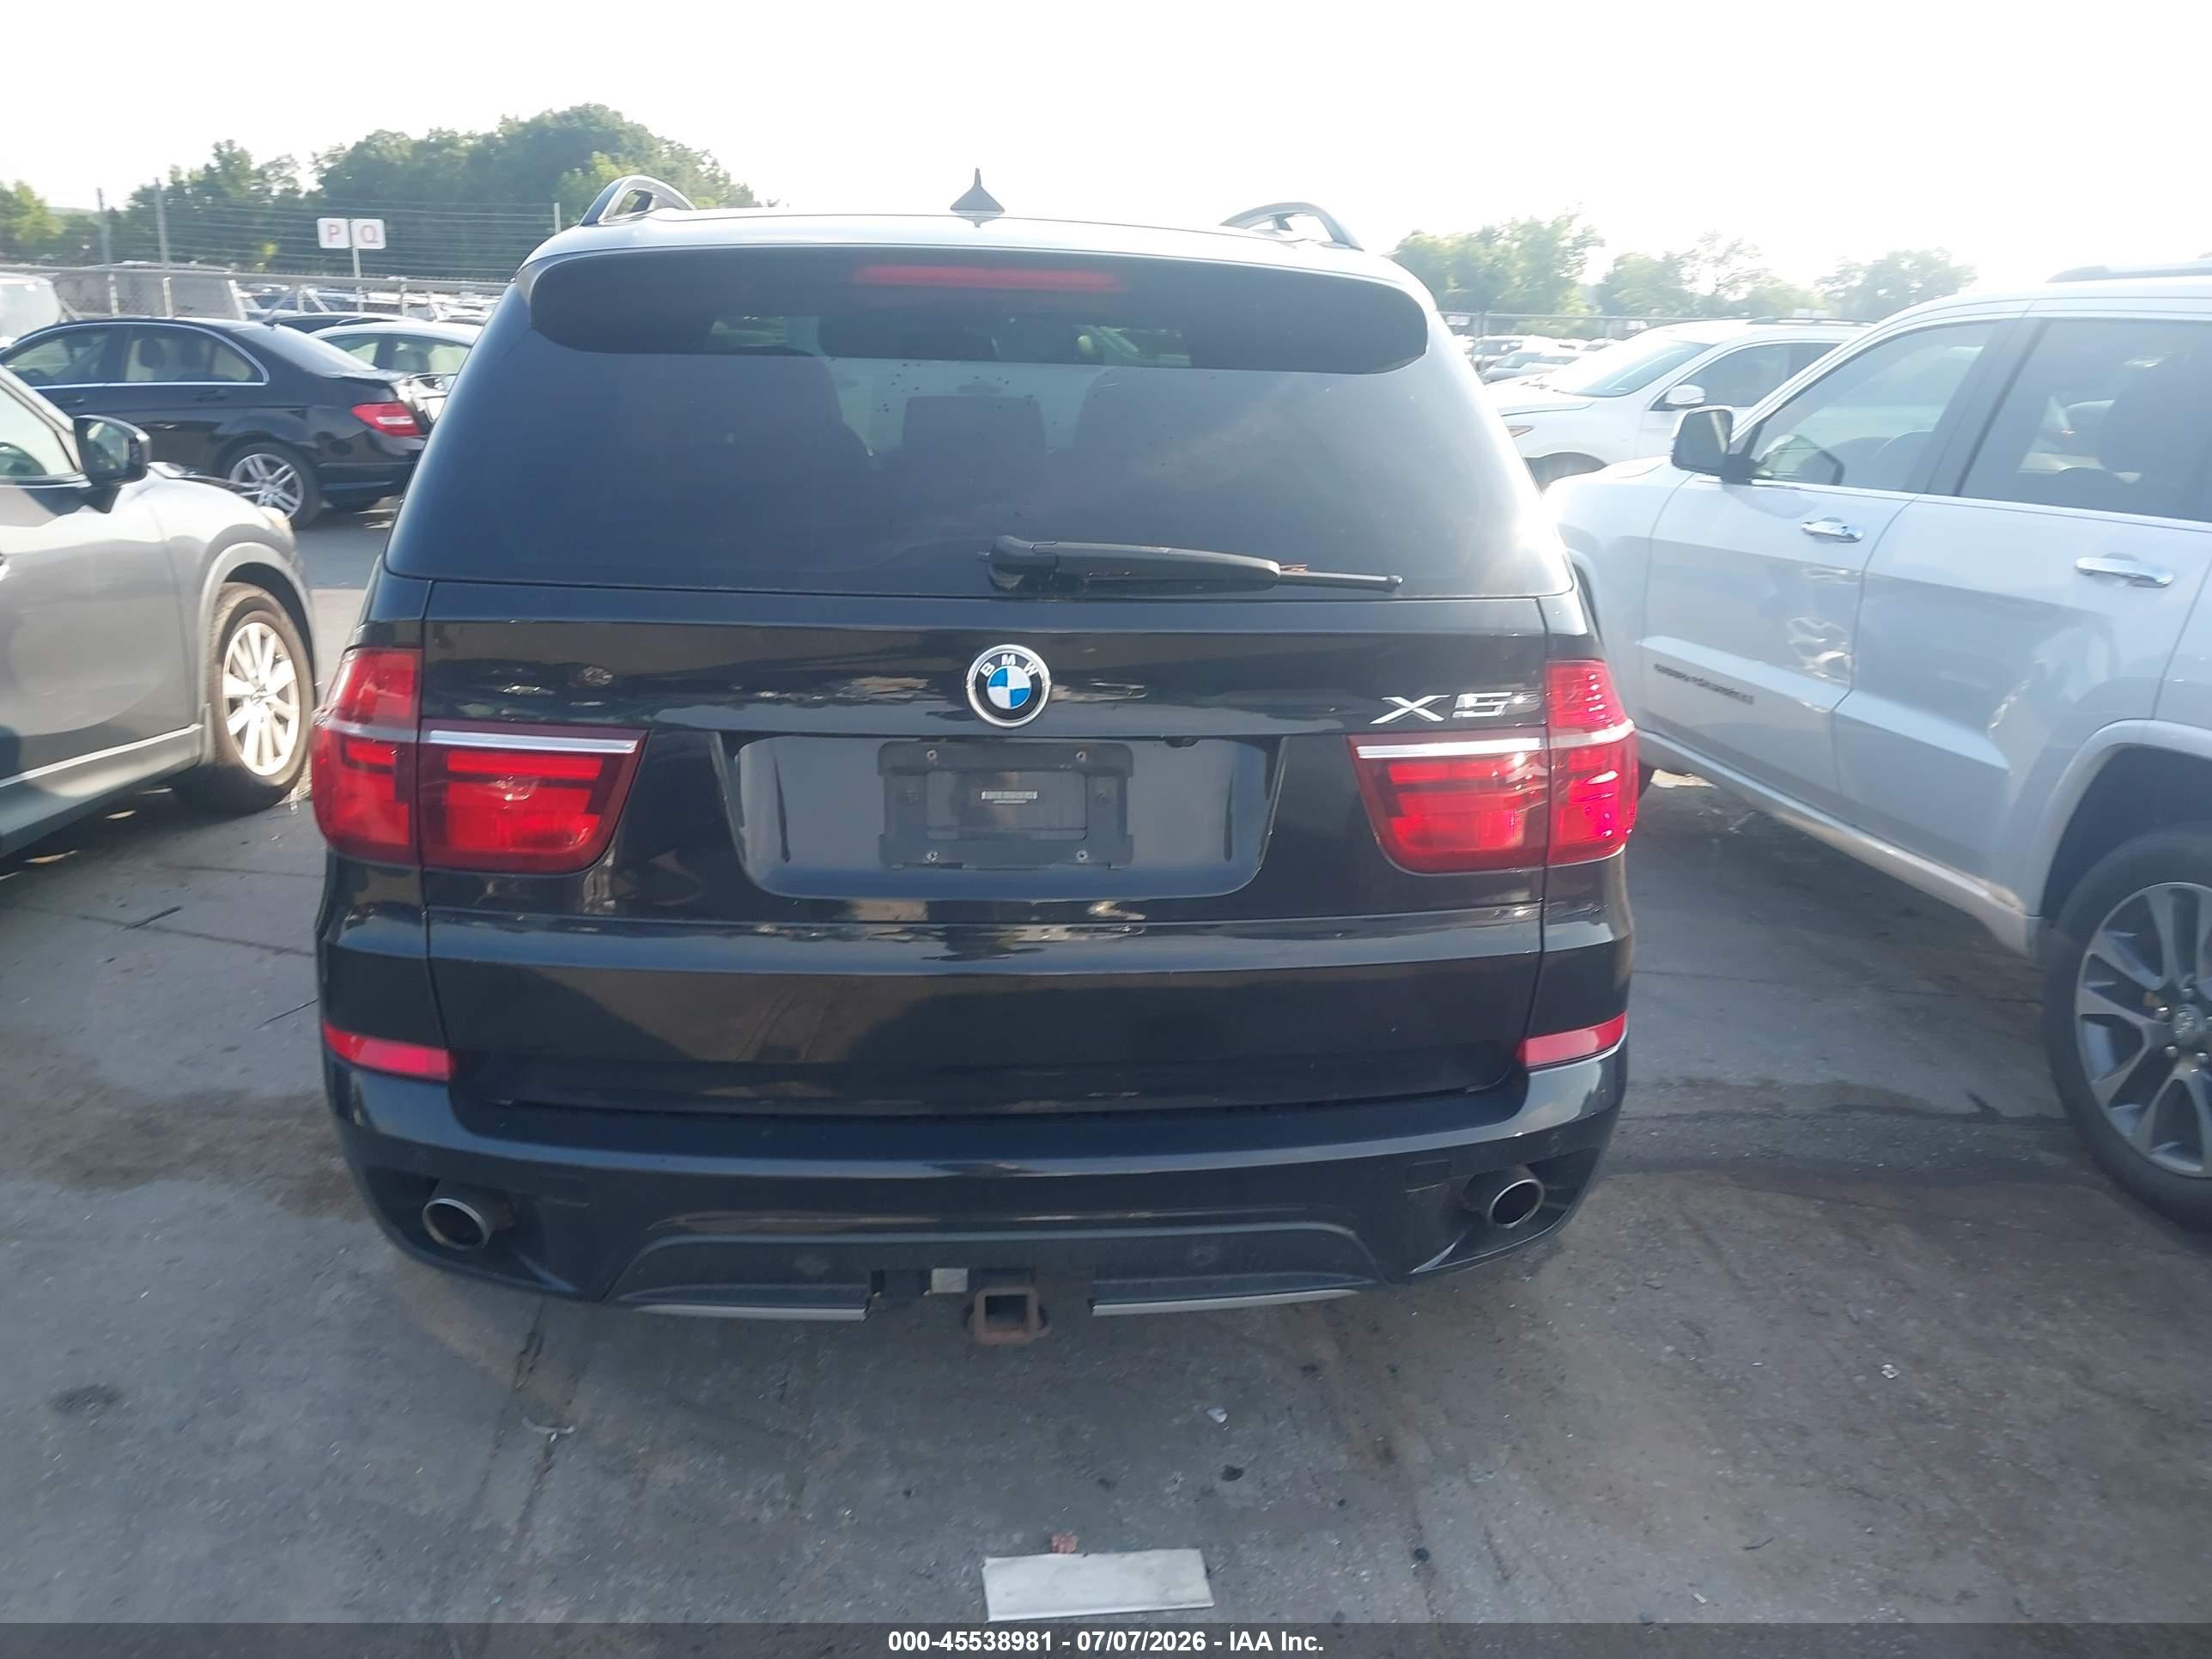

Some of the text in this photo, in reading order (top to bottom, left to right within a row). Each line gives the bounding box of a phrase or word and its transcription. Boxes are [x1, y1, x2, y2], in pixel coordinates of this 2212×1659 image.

[327, 224, 342, 242] P
[360, 224, 380, 244] Q
[979, 653, 1039, 678] BMW
[1369, 691, 1514, 725] X5
